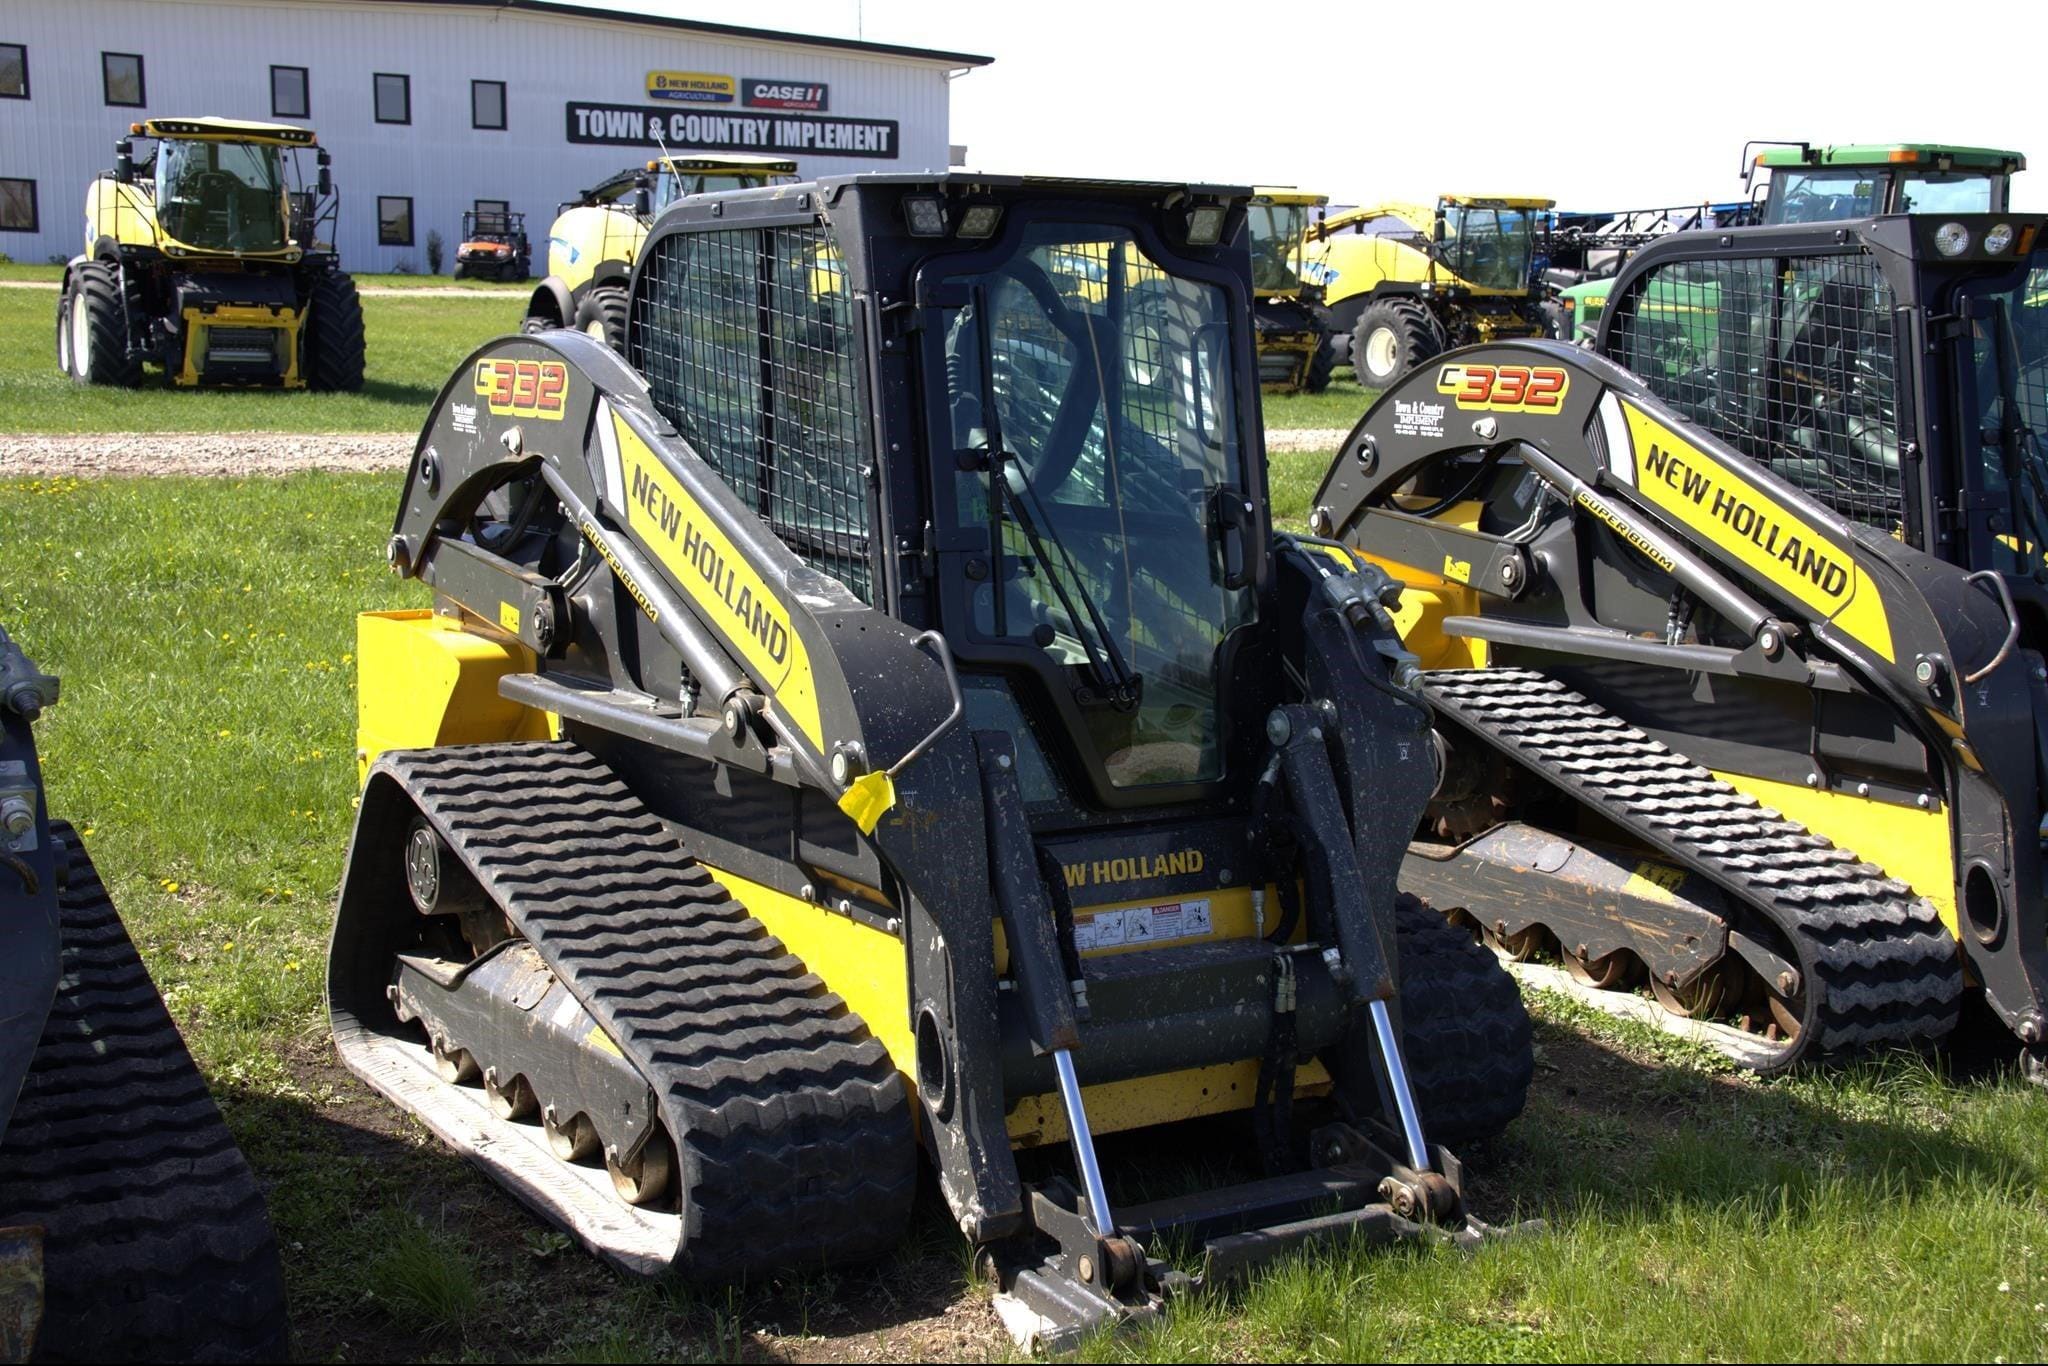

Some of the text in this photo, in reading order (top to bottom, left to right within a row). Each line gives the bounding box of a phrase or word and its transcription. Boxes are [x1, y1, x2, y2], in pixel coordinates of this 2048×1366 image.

[668, 92, 716, 100] AGRICULTURE
[669, 79, 729, 90] NEW HOLLAND
[754, 84, 806, 100] CASE
[575, 109, 891, 151] TOWN & COUNTRY IMPLEMENT
[1579, 493, 1673, 569] SUPER BOOM
[1645, 443, 1848, 597] NEW HOLLAND
[583, 523, 657, 619] SUPER BOOM
[632, 463, 788, 665] NEW HOLLAND
[1093, 850, 1204, 884] HOLLAND
